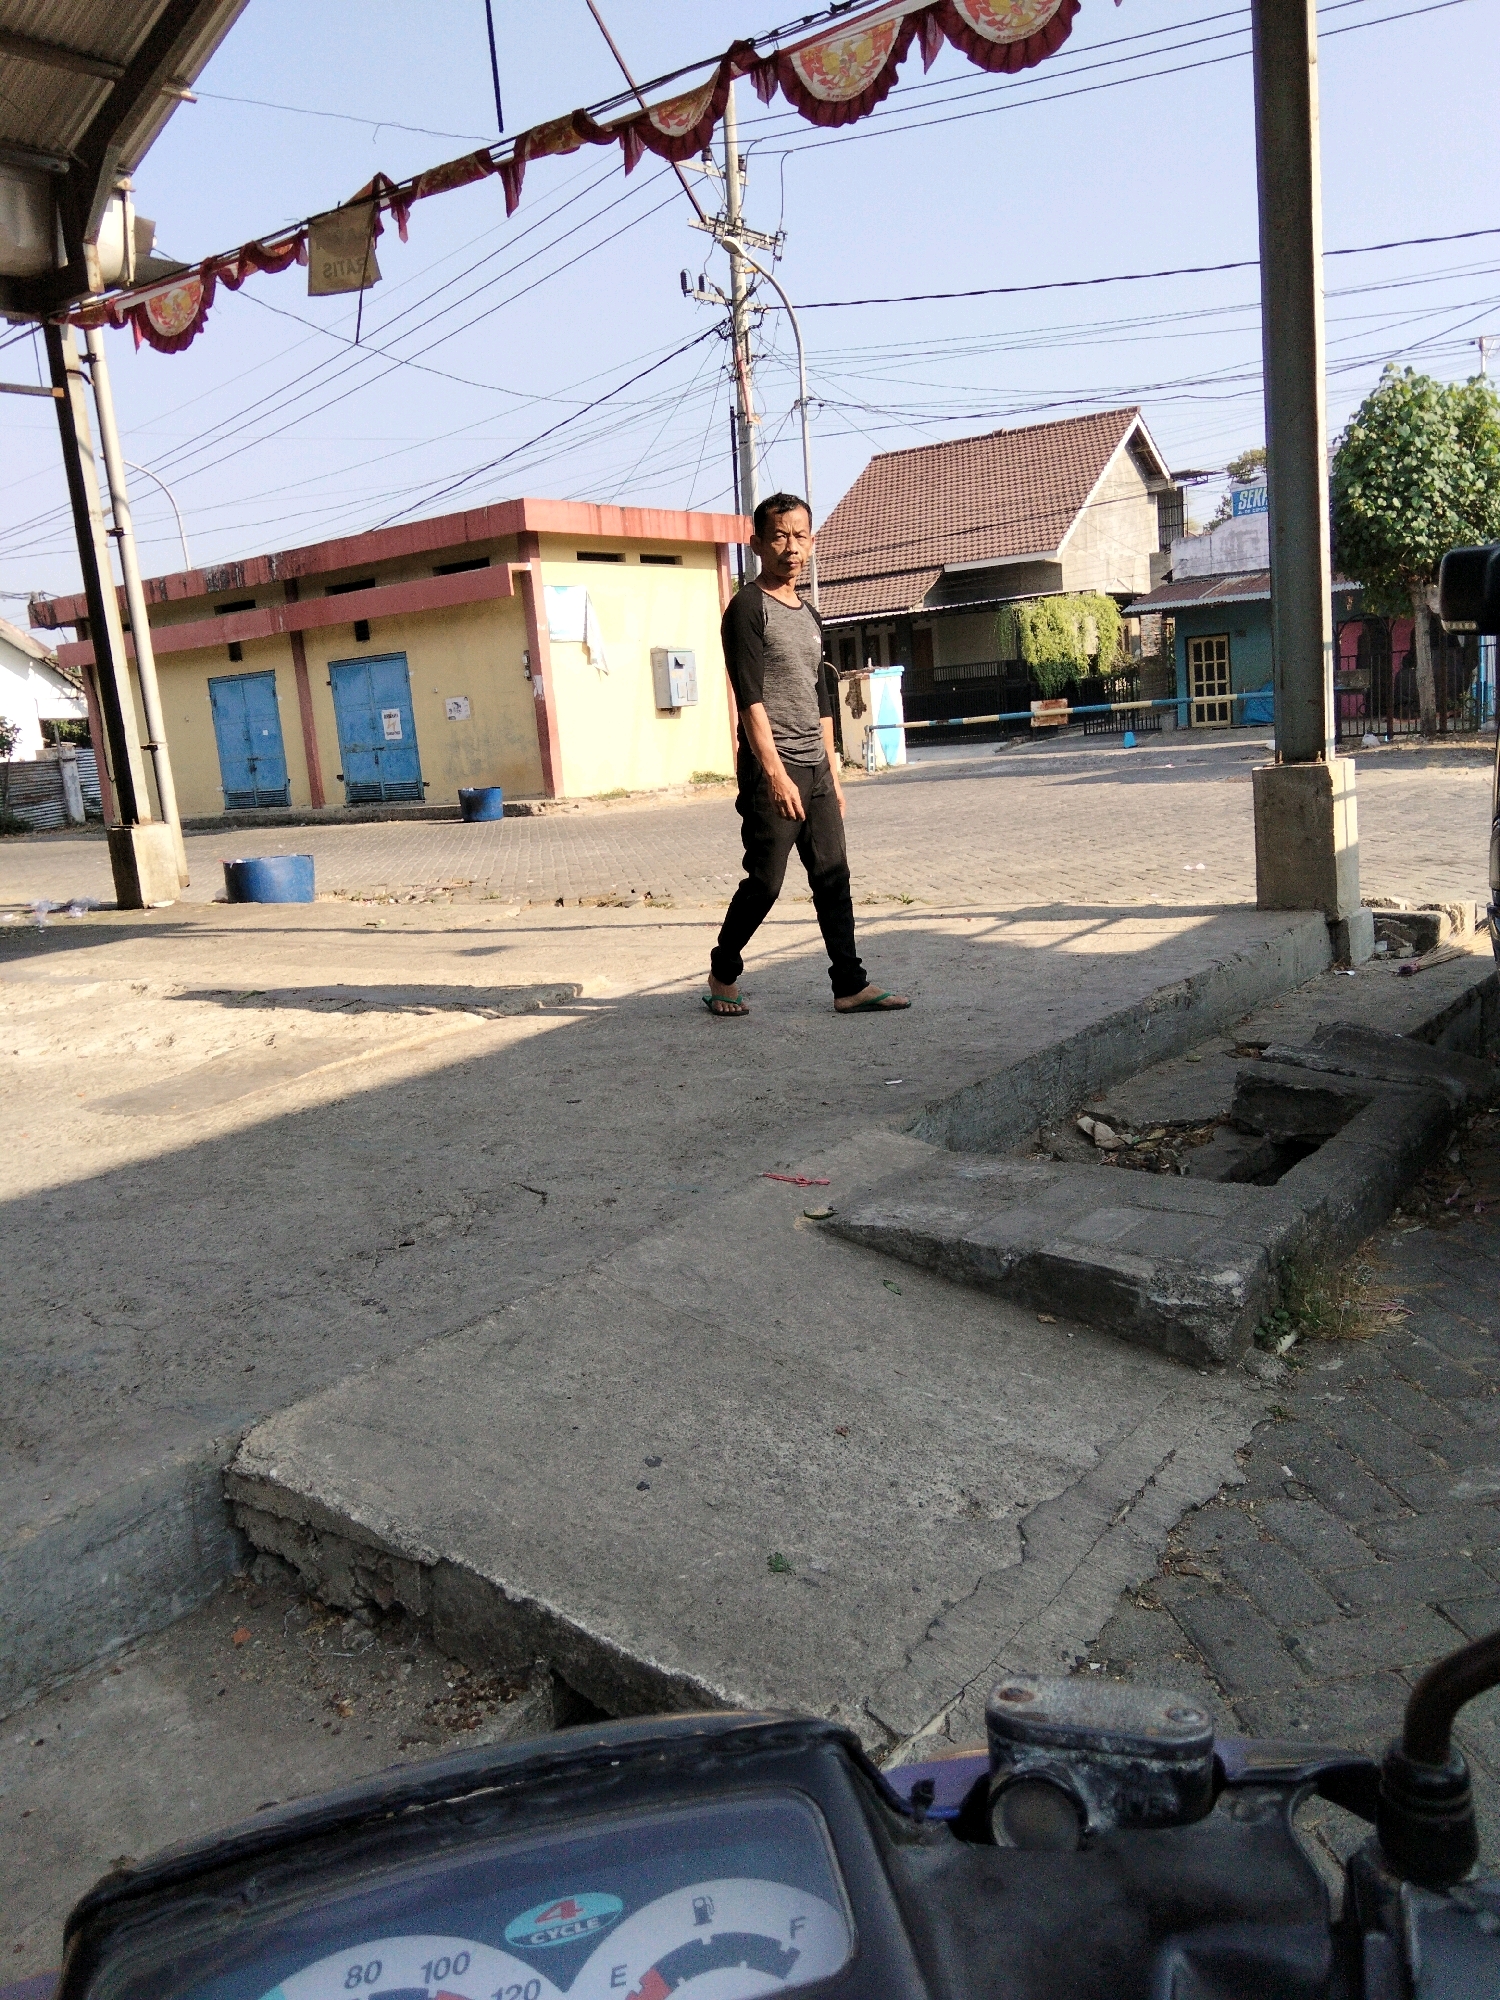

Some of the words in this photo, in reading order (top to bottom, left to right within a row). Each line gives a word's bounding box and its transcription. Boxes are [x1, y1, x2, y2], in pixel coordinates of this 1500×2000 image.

[535, 1900, 584, 1924] 4
[530, 1917, 600, 1945] CYCLE
[790, 1915, 807, 1940] F
[343, 1959, 383, 1990] 80
[420, 1951, 471, 1984] 100
[610, 1963, 628, 1989] E
